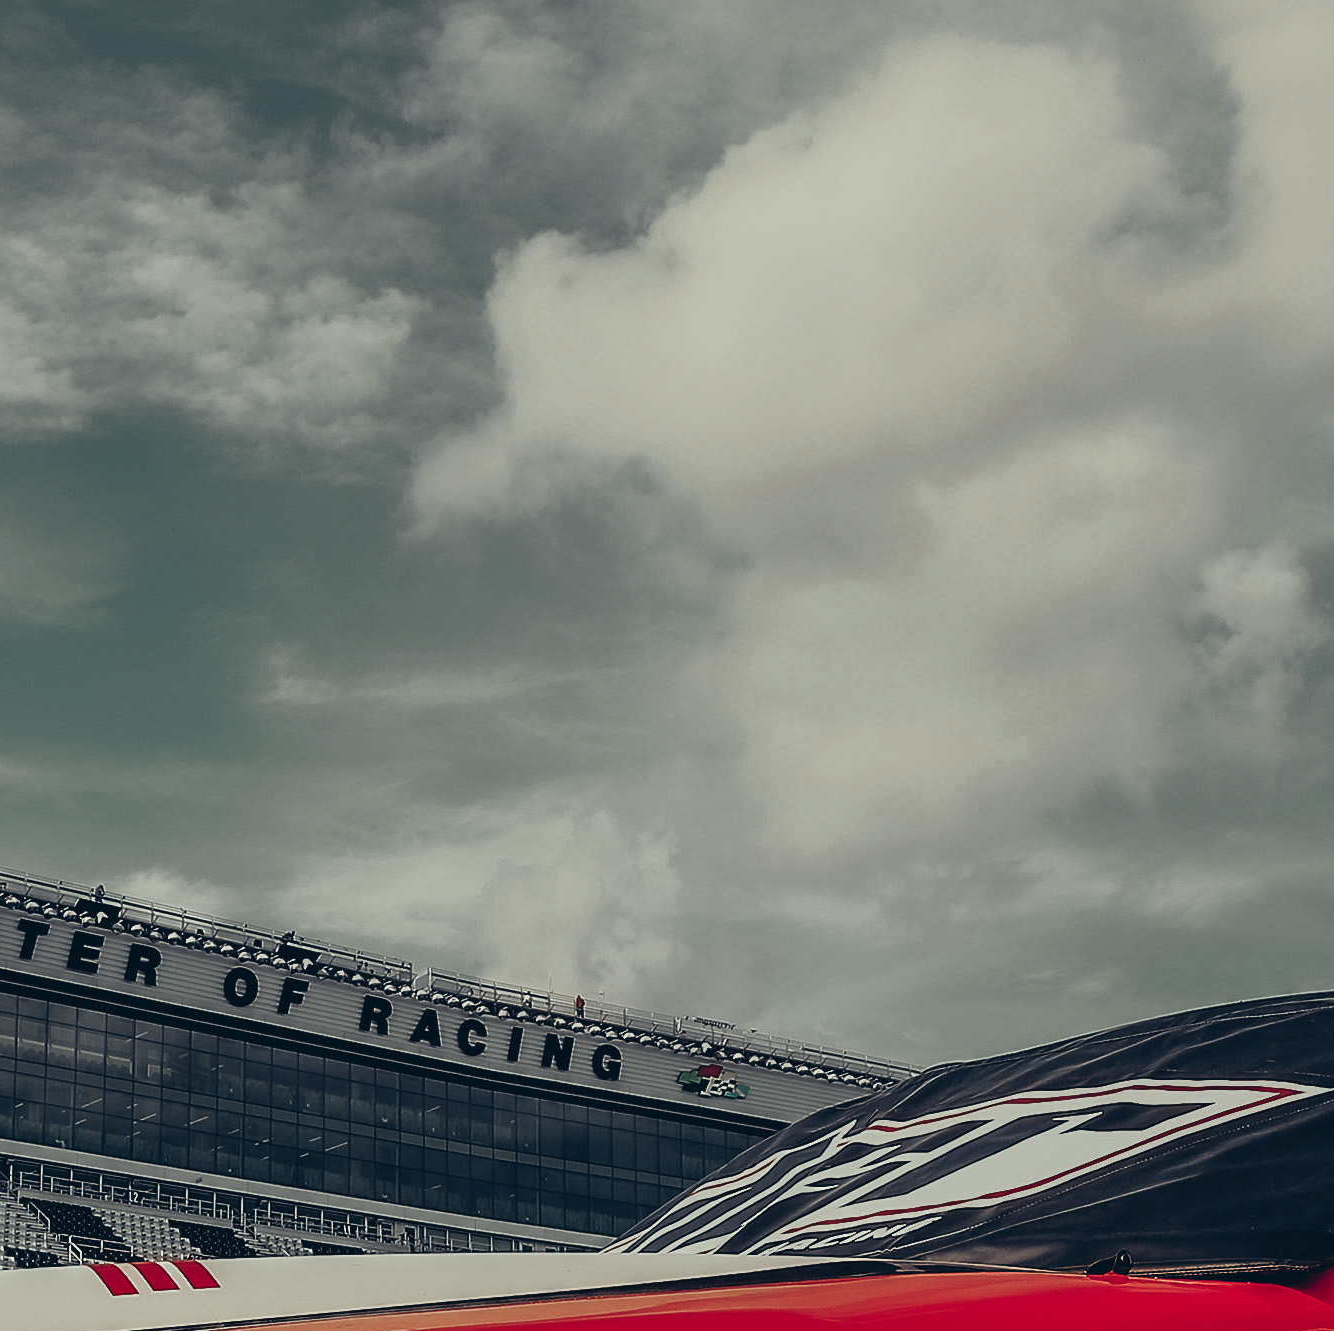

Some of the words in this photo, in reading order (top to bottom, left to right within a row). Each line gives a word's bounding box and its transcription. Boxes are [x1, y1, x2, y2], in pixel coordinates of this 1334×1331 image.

[223, 967, 310, 1014] OF
[359, 994, 623, 1081] RACING
[128, 1191, 139, 1203] L2
